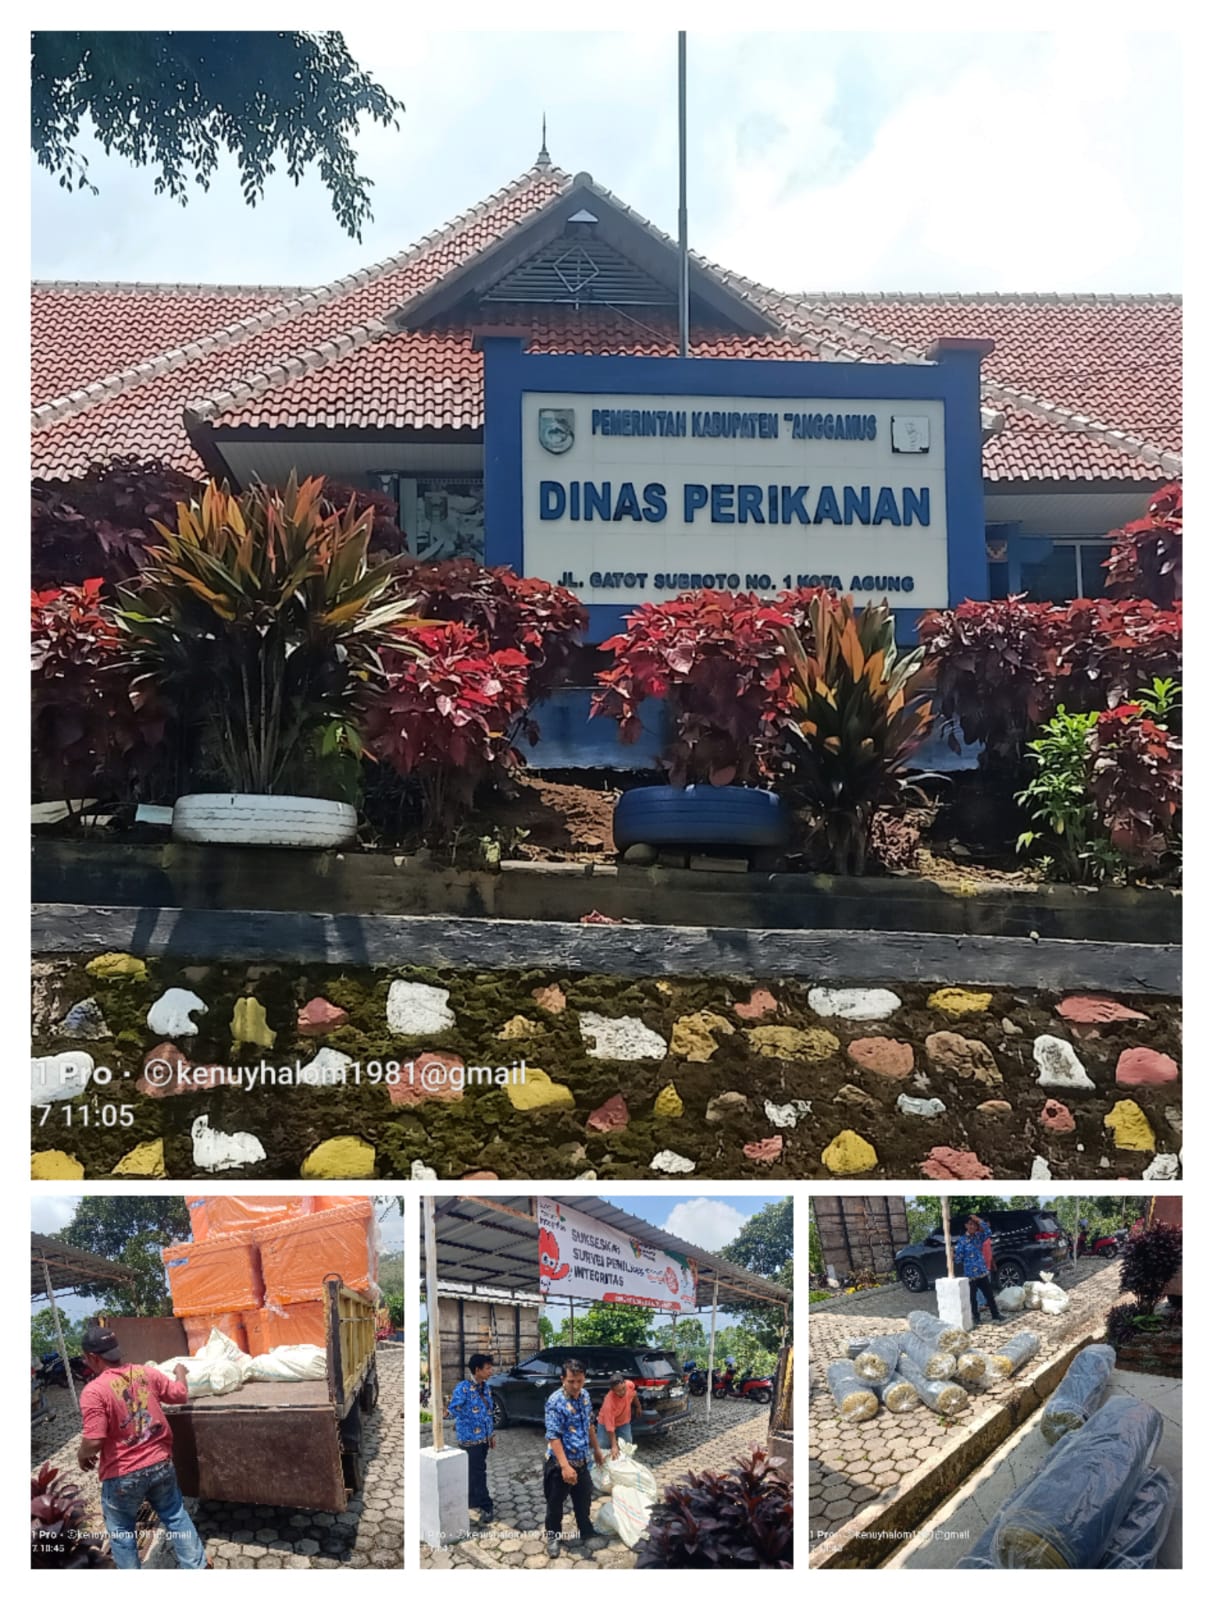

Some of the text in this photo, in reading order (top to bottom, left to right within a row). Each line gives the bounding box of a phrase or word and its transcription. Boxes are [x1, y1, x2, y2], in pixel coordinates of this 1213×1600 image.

[592, 409, 687, 437] PEMERINTAH
[692, 411, 779, 439] KABUPATEN
[539, 481, 930, 526] DINAS PERIKANAN
[557, 571, 914, 592] JL. GATOT SUBROTO NO. 1 KOTA AGUNG
